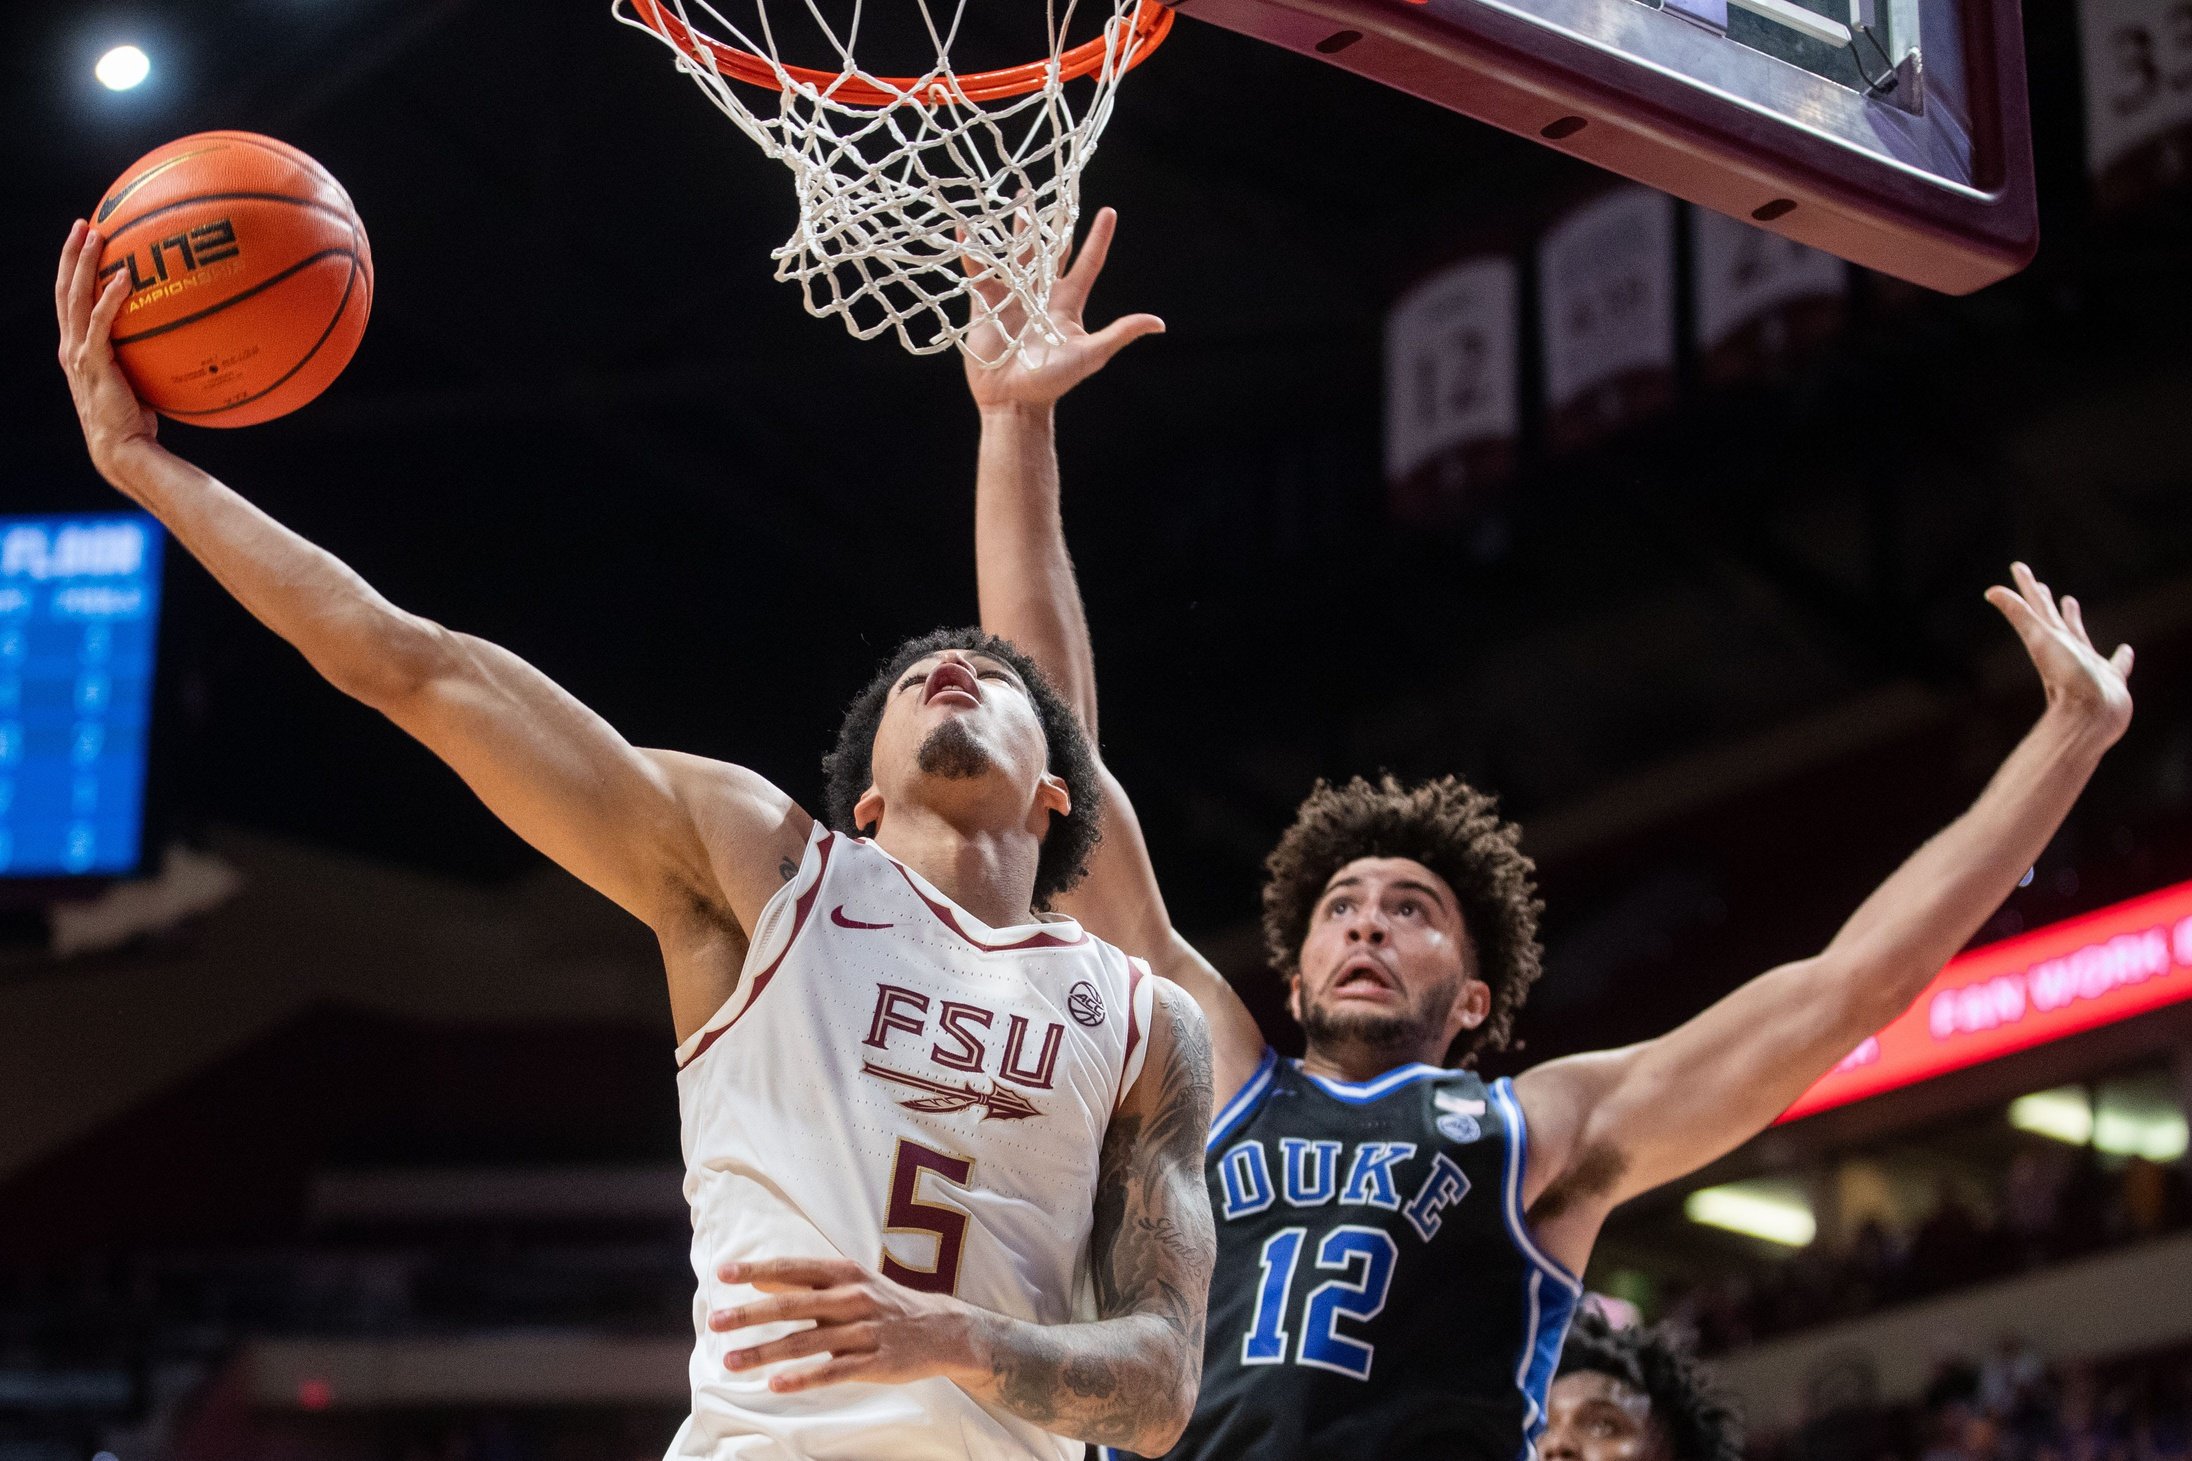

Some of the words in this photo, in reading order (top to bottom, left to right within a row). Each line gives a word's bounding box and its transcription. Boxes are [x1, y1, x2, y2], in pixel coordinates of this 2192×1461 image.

[862, 983, 1065, 1090] FSU
[878, 1136, 977, 1297] 5
[1217, 1137, 1473, 1243] DUKE
[1241, 1224, 1399, 1382] 12
